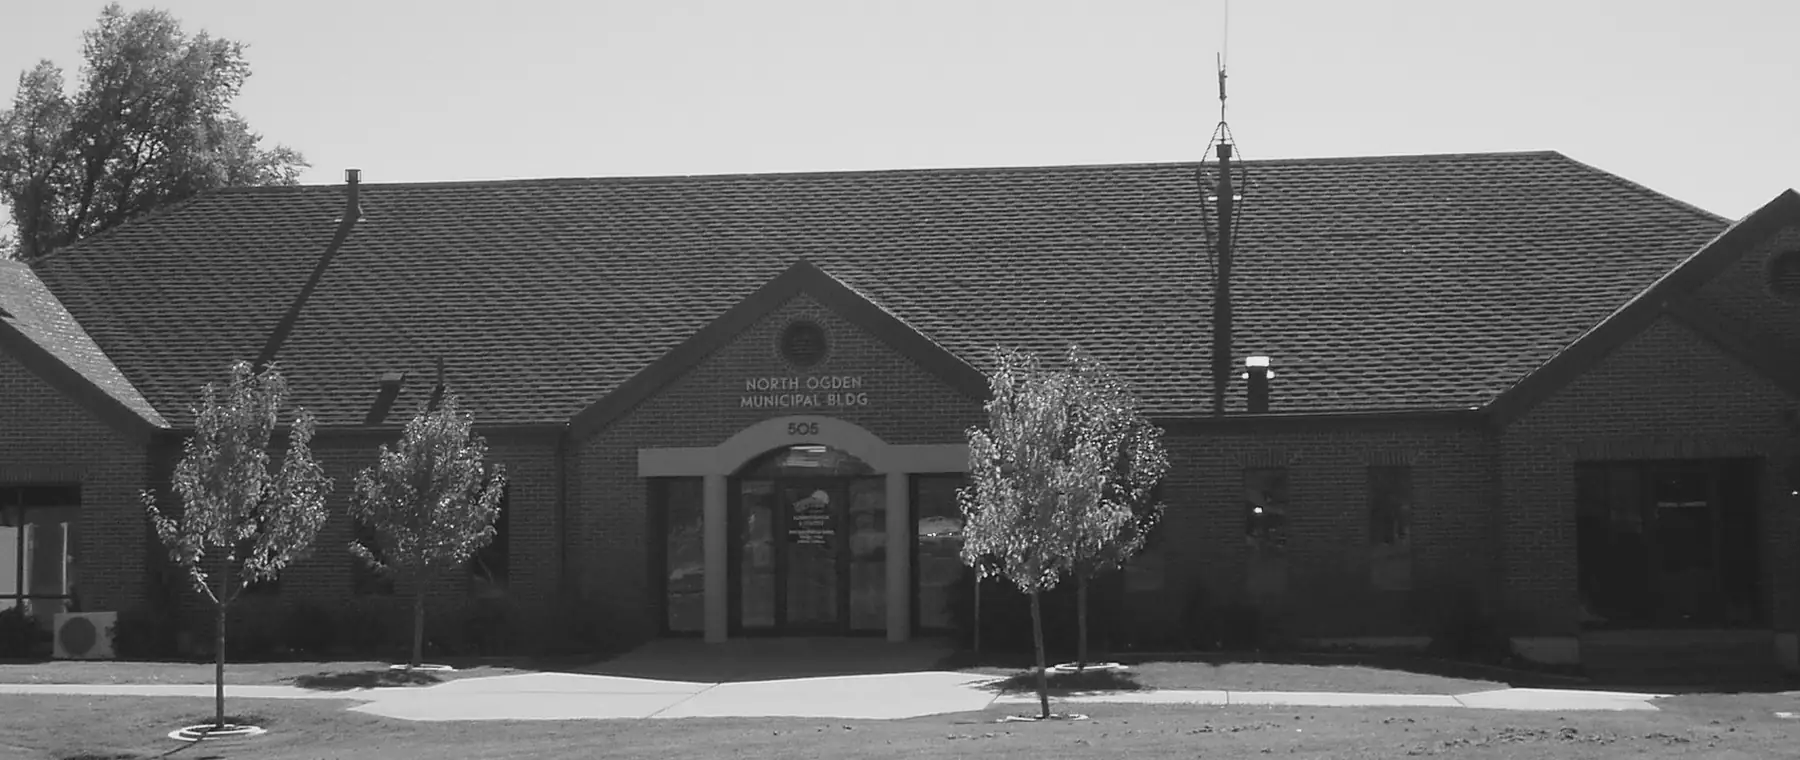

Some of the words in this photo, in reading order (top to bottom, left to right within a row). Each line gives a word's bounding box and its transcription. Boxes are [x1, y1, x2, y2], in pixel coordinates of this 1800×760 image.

[746, 376, 799, 391] NORTH
[806, 375, 862, 389] OGDEN
[740, 393, 821, 408] MUNICIPAL
[827, 392, 868, 406] BLDG
[787, 422, 819, 435] 505
